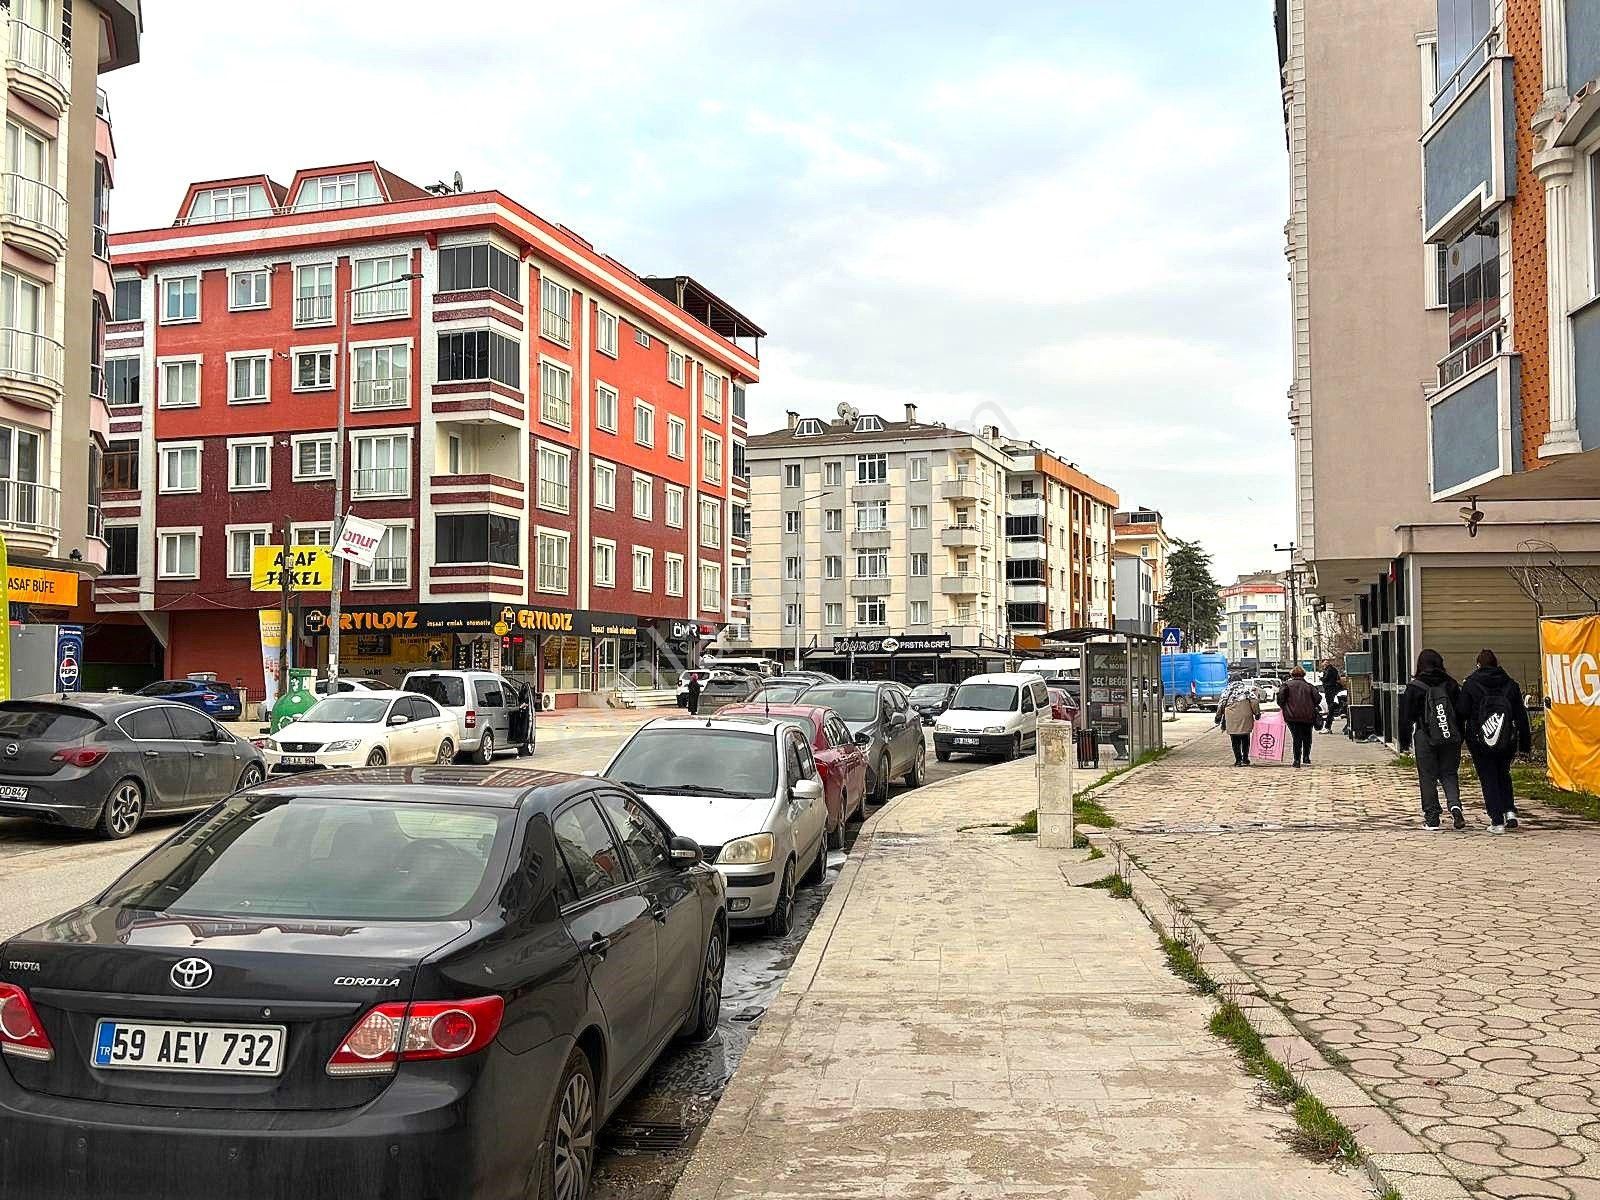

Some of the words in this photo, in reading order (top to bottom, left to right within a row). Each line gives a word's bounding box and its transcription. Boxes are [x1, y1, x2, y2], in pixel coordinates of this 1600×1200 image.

[342, 530, 379, 549] onur
[8, 577, 31, 591] ASAF
[33, 577, 55, 594] BÜFE
[517, 609, 573, 631] ERYILDIZ
[1436, 703, 1451, 739] adidas
[1482, 712, 1501, 738] NIKE
[9, 961, 41, 972] TOYOTA
[334, 976, 401, 988] COROLLA
[100, 1046, 111, 1056] TR
[112, 1028, 147, 1061] 59
[156, 1030, 209, 1064] AEV
[220, 1033, 274, 1067] 732
